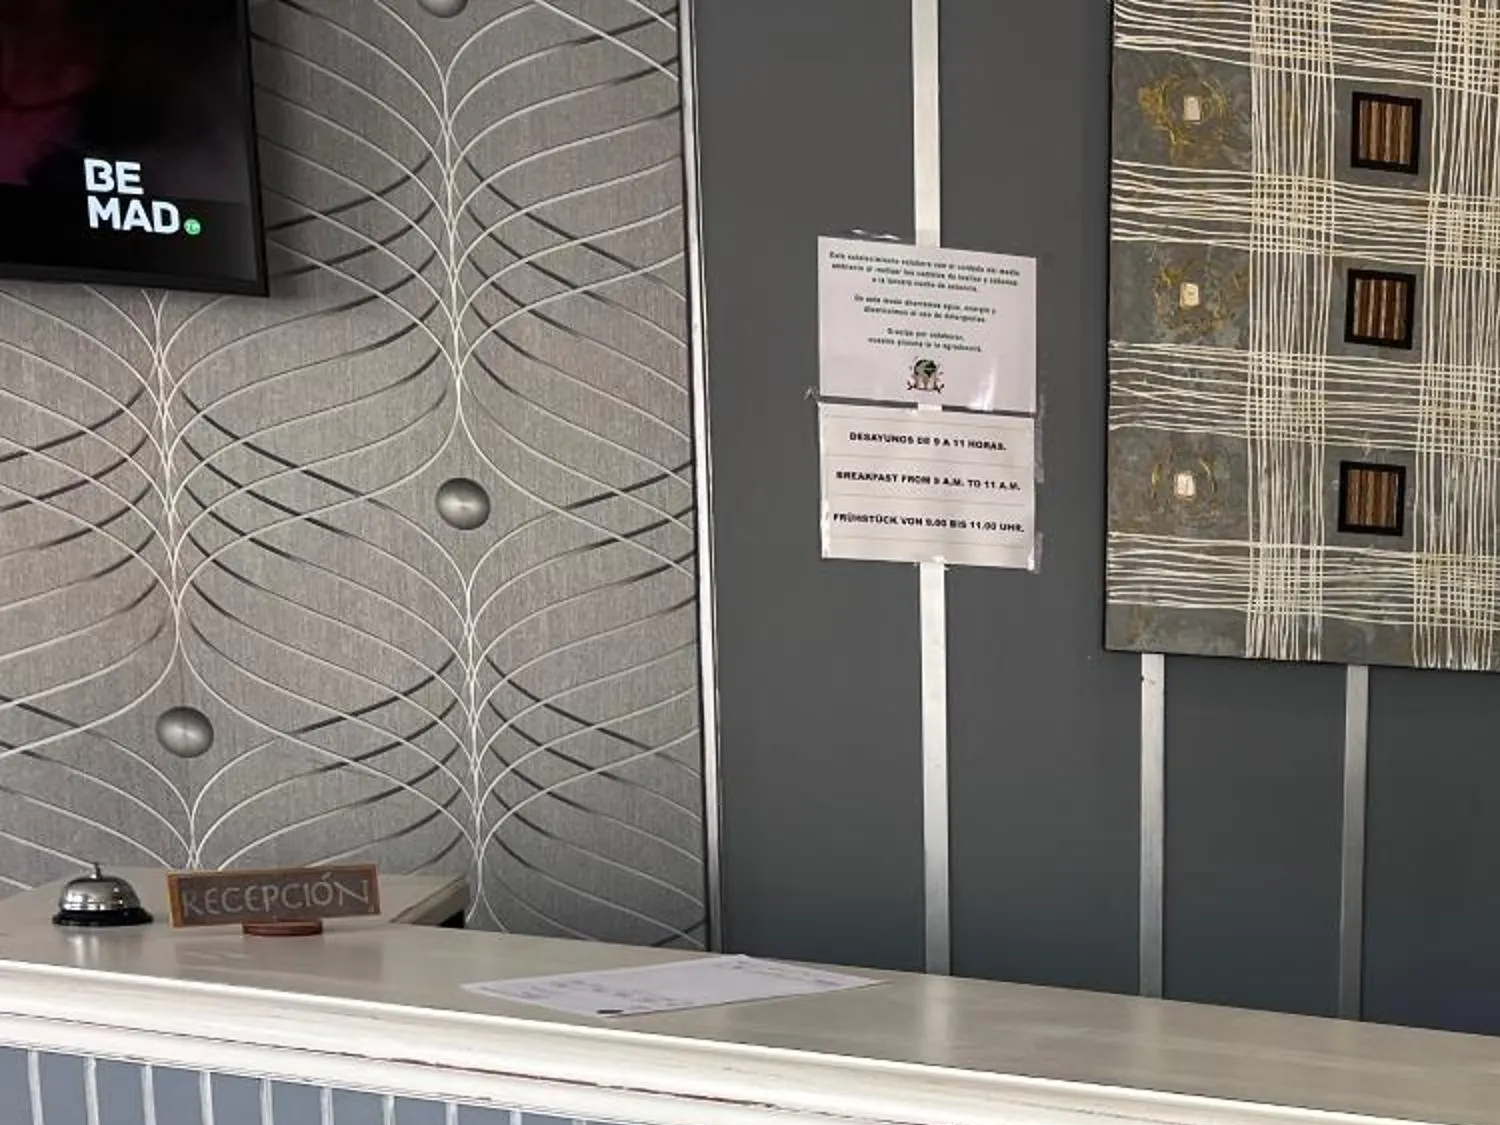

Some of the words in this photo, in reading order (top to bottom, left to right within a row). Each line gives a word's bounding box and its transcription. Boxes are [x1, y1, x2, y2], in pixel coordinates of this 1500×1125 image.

[84, 158, 144, 194] BE
[849, 431, 914, 445] DESAYUNOS
[942, 437, 951, 447] A
[953, 439, 966, 449] 11
[835, 470, 898, 484] BREAKFAST
[901, 474, 931, 486] FROM
[967, 479, 982, 489] TO
[984, 480, 996, 490] 11
[900, 515, 924, 527] VON
[949, 519, 968, 530] BIS
[182, 871, 370, 917] RECEPCIÓN
